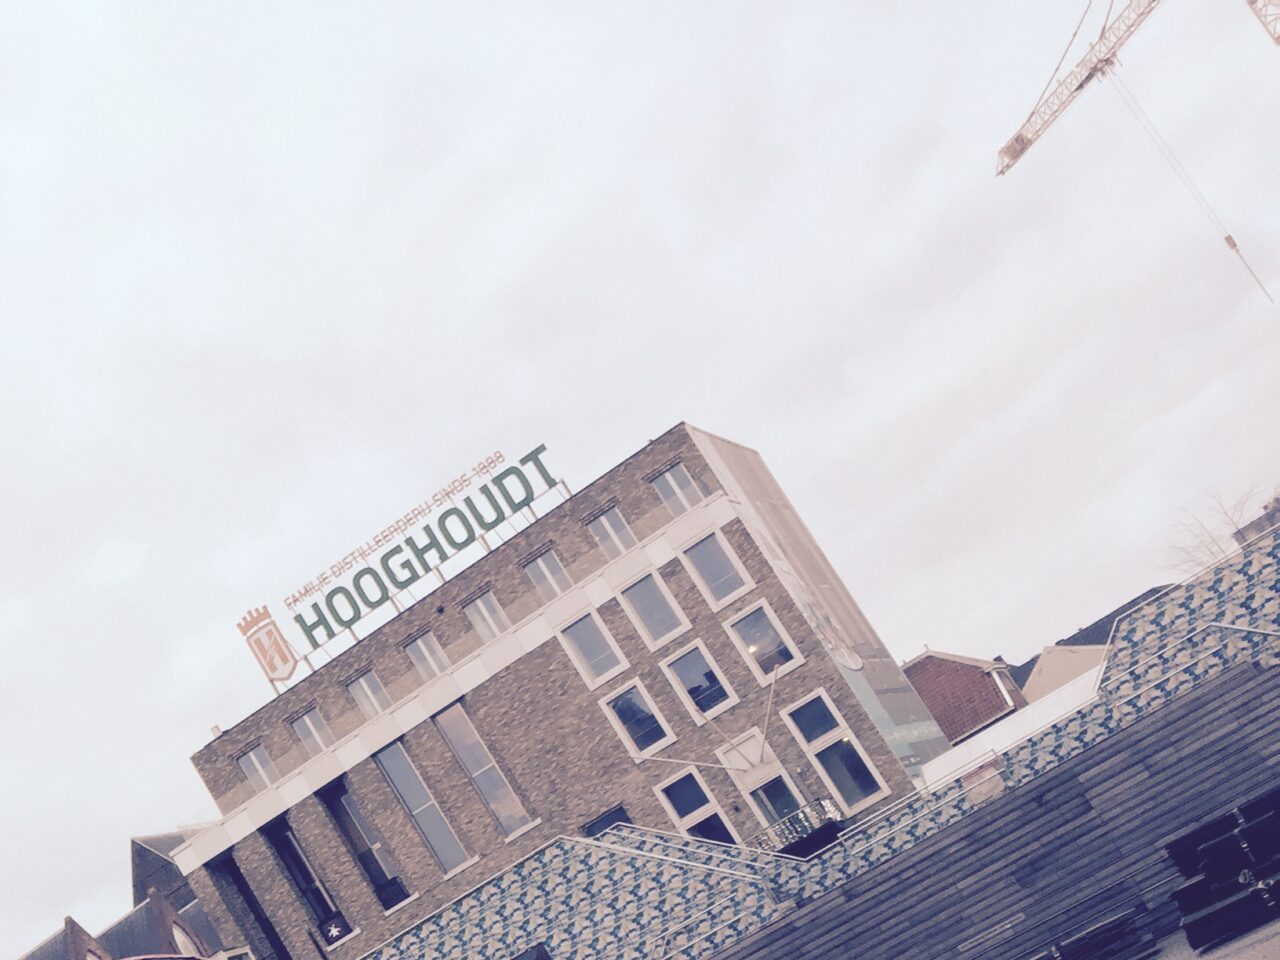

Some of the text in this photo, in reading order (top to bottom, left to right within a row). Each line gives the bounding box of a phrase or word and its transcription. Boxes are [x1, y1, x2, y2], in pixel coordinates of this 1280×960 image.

[283, 450, 506, 610] FAMILIE DISTILLEERDERIJ SINDS 1888
[293, 443, 558, 650] HOOGHOUDT
